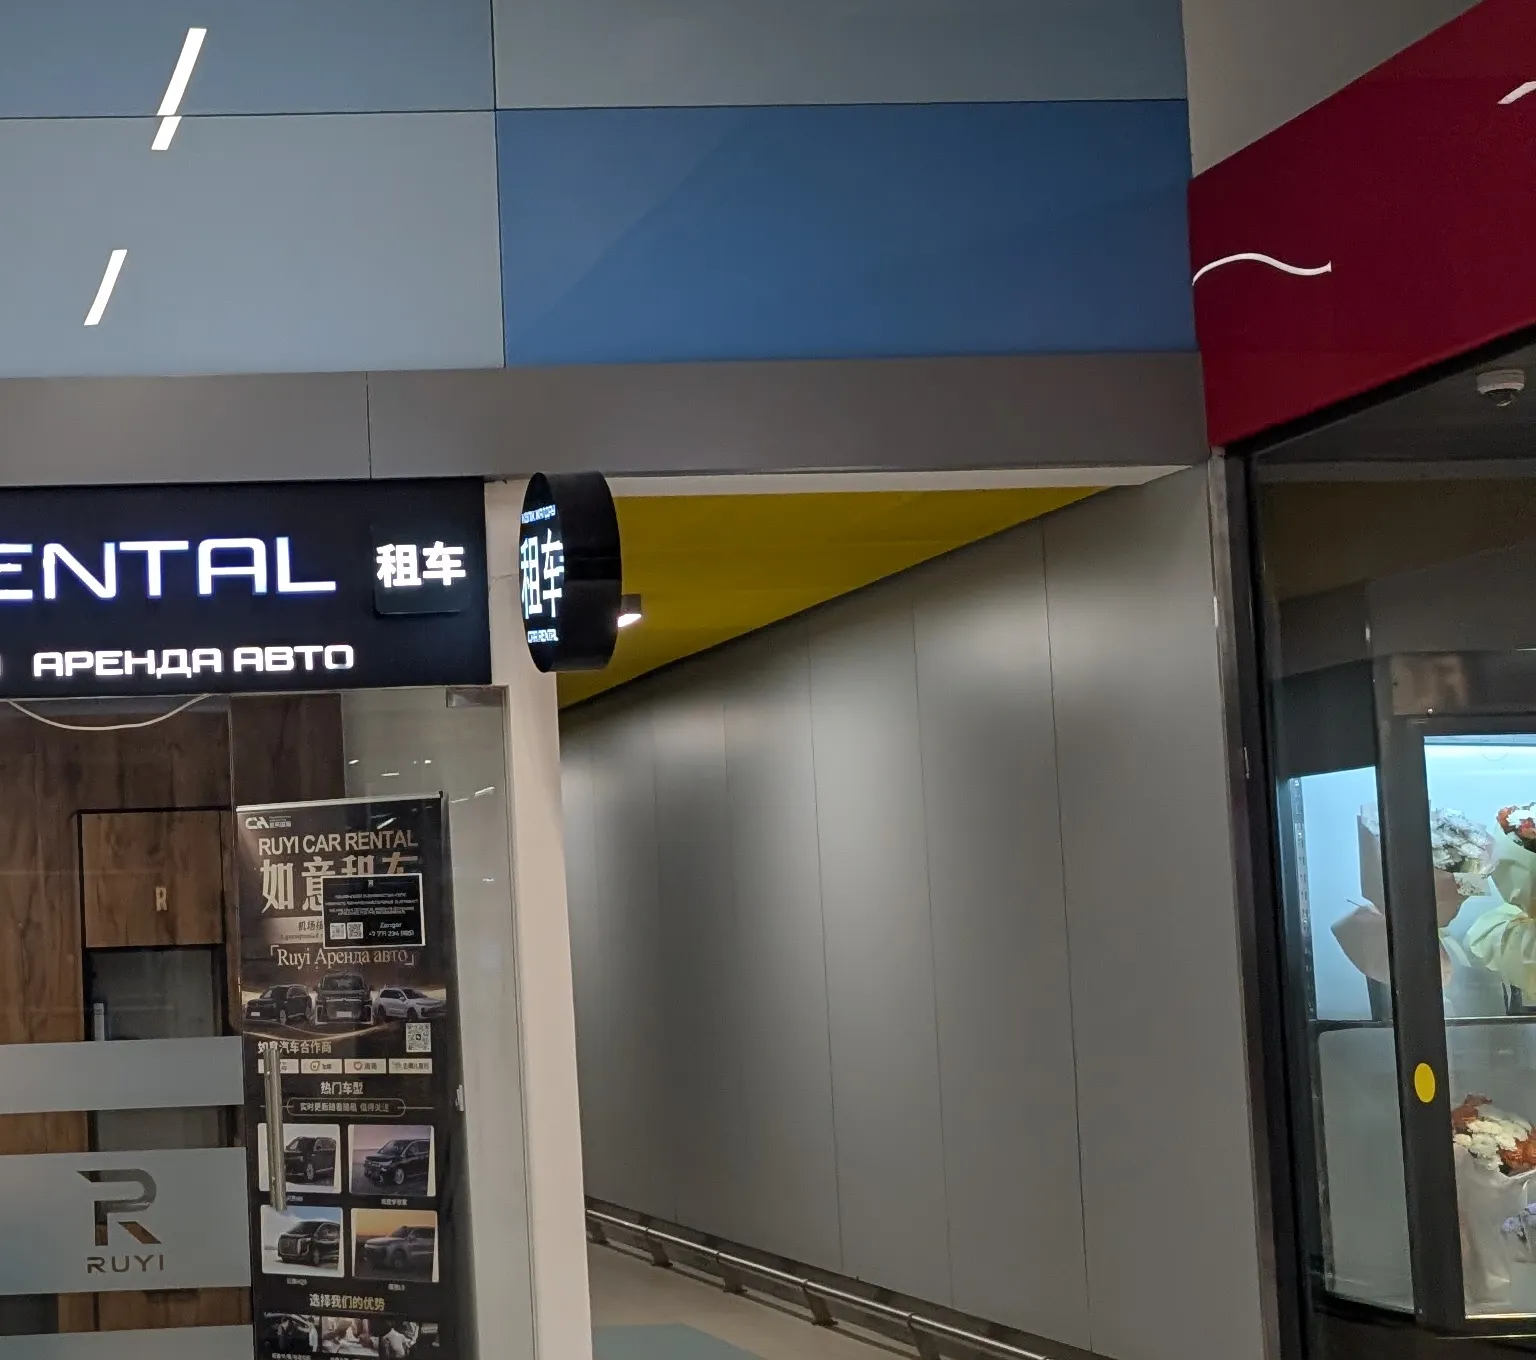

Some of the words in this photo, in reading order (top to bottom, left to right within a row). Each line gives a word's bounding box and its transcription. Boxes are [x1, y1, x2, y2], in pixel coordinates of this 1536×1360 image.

[376, 541, 466, 588] 租车
[520, 528, 564, 620] 租车
[32, 645, 223, 680] АРЕНДА
[233, 644, 355, 673] АВТО
[258, 835, 299, 856] RUYI
[302, 833, 342, 853] CAR
[345, 829, 419, 851] RENTAL
[155, 887, 167, 911] R
[315, 948, 370, 969] Аренда
[320, 1081, 364, 1095] 热门车型
[87, 1254, 164, 1274] RUYI
[309, 1293, 385, 1311] 选择我们的优势
